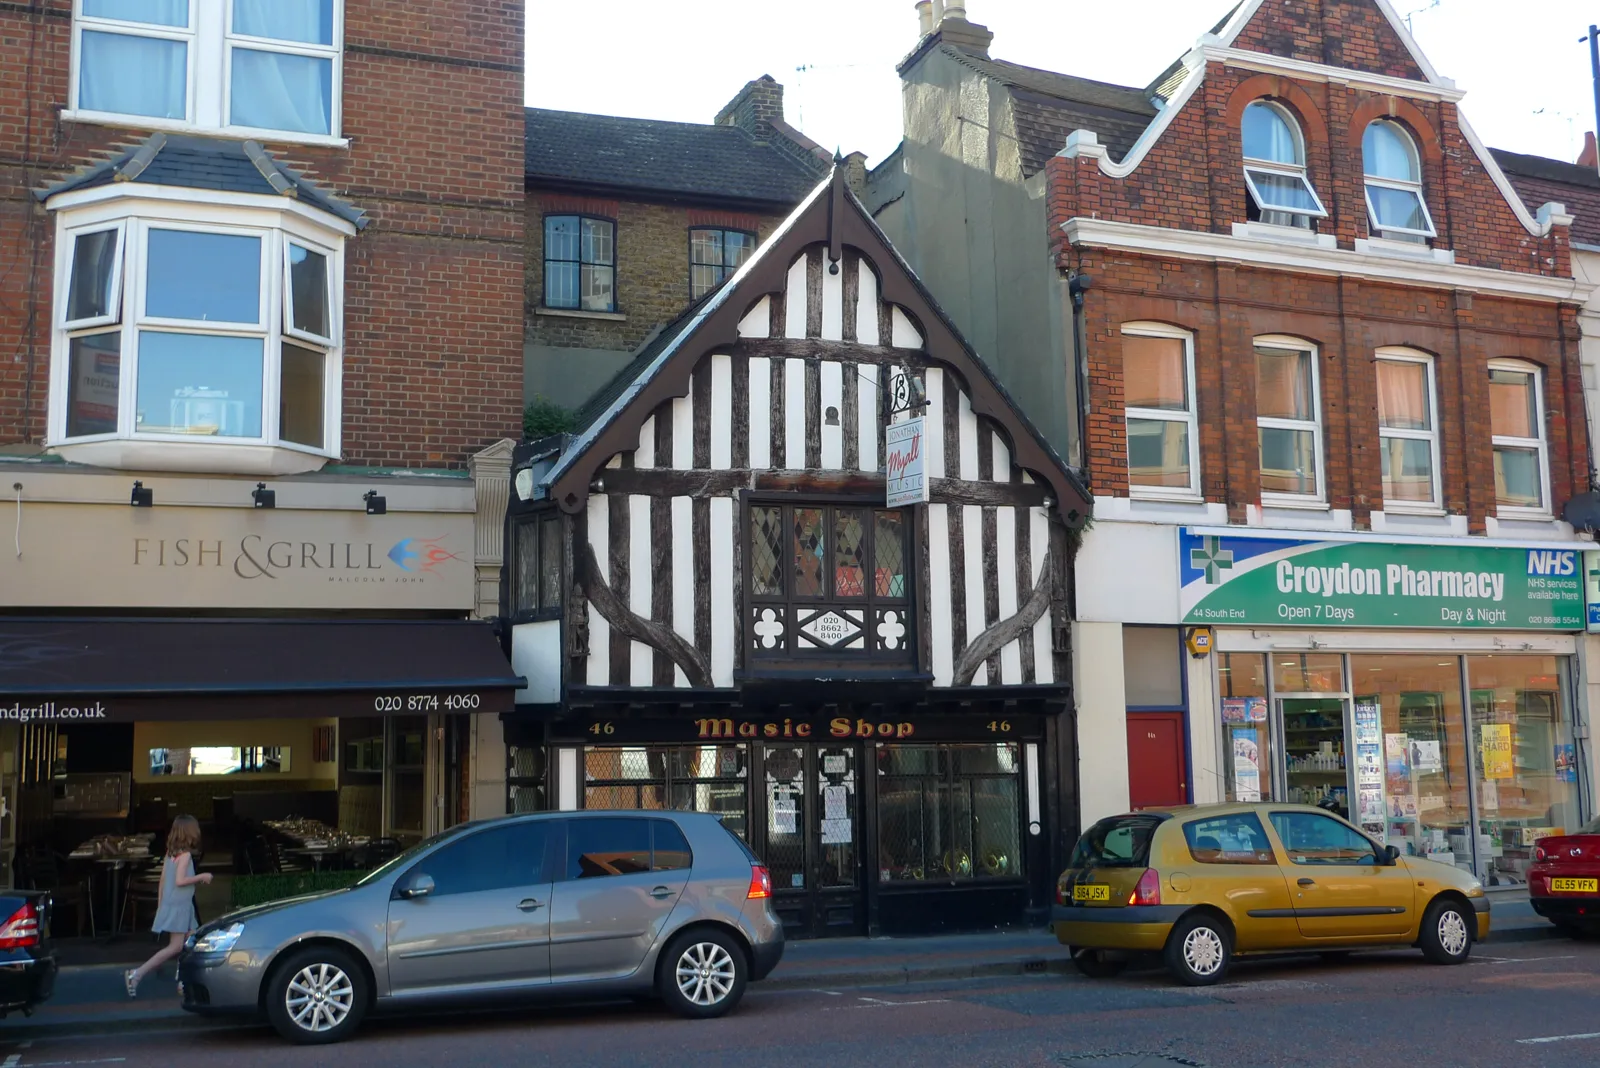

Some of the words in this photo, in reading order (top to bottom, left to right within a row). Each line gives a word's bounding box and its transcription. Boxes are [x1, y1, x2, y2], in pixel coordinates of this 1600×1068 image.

[889, 425, 920, 442] JONATHAN
[888, 432, 920, 480] Myall
[888, 476, 923, 492] MUSIC
[133, 538, 223, 567] FISH
[267, 541, 382, 569] GRILL
[1527, 550, 1575, 575] NHS
[1276, 560, 1381, 597] Croydon
[1386, 564, 1505, 601] Pharmacy
[1527, 578, 1545, 588] NHS
[1547, 579, 1577, 588] services
[1527, 590, 1560, 600] available
[1561, 590, 1579, 600] here
[1193, 608, 1203, 617] 44
[1205, 608, 1228, 618] South
[1229, 609, 1245, 618] End
[1278, 603, 1311, 620] Open
[1314, 605, 1322, 618] 7
[1325, 605, 1355, 621] Days
[1441, 607, 1463, 623] Day
[1465, 608, 1474, 621] &
[1477, 608, 1506, 624] Night
[1528, 616, 1541, 624] 020
[1196, 637, 1208, 645] ADT
[374, 696, 402, 711] 020
[407, 695, 439, 710] 8774
[444, 694, 480, 710] 4060
[0, 702, 106, 722] ndgrill.co.uk
[589, 721, 615, 735] 46
[694, 718, 811, 738] Music
[830, 717, 914, 738] Shop
[986, 720, 1011, 732] 46
[1484, 742, 1510, 752] HARD
[1554, 880, 1576, 890] GL55
[1577, 880, 1594, 890] VFK
[1092, 887, 1106, 899] JSK
